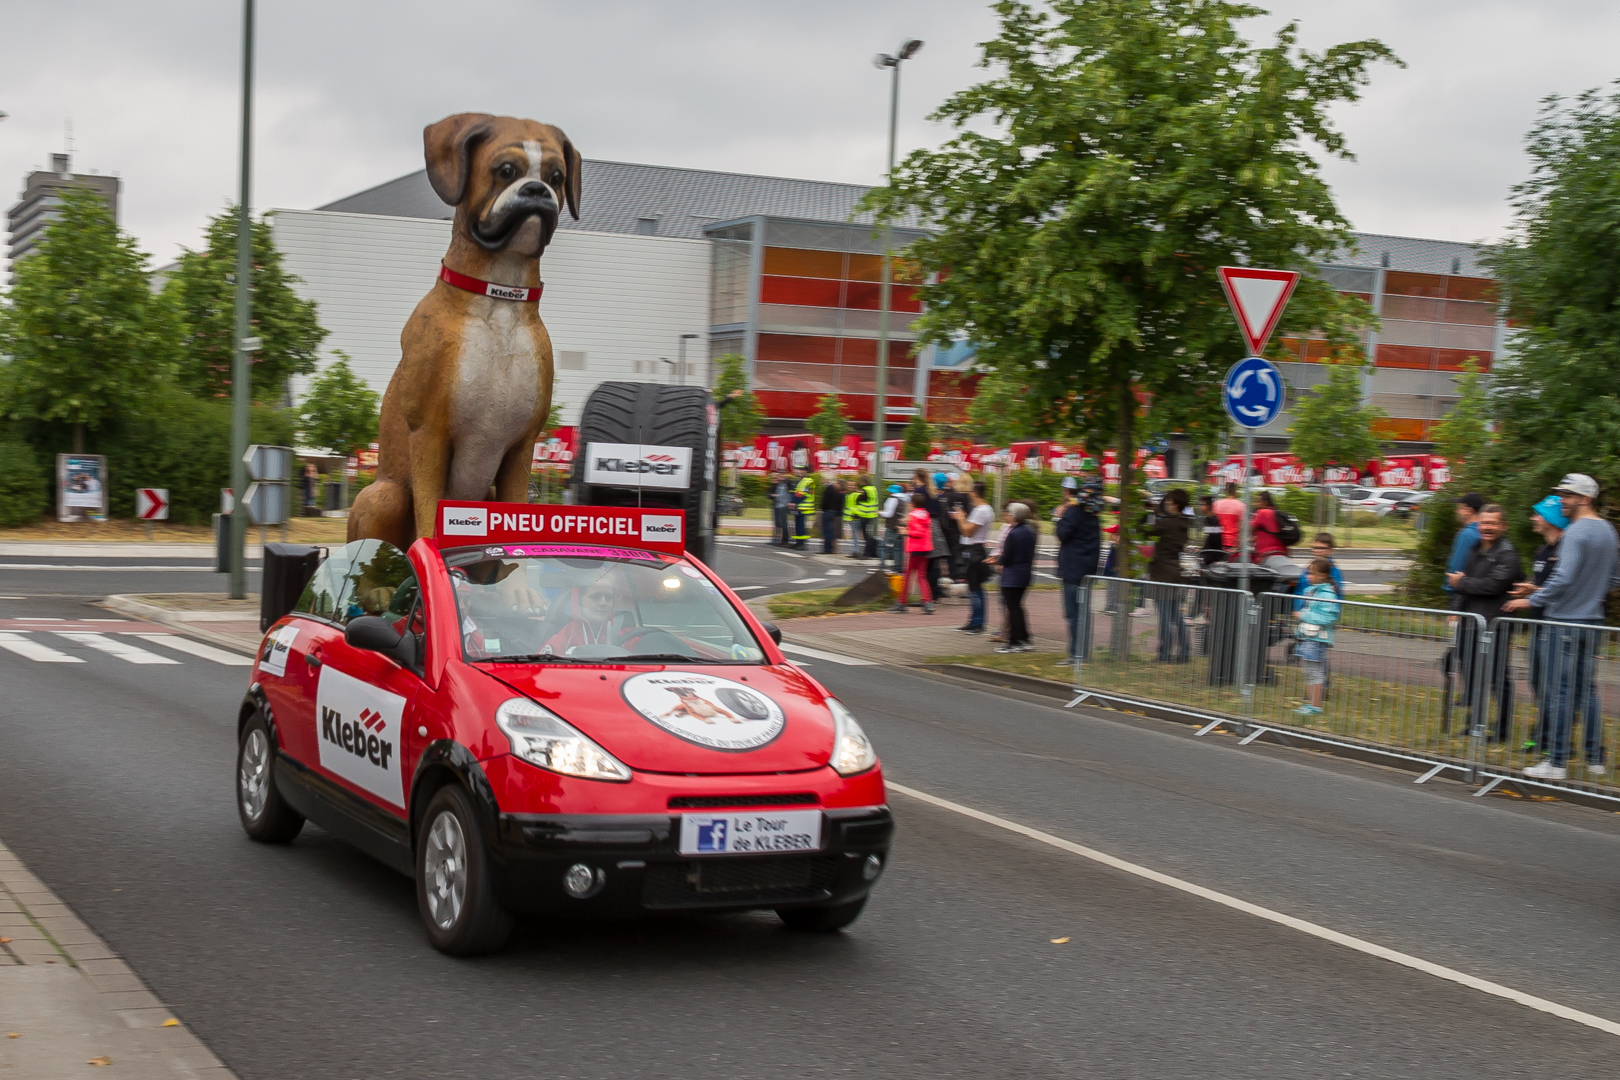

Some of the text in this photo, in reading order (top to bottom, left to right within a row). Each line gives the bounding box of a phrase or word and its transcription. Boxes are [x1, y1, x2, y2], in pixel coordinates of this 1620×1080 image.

[491, 288, 524, 299] Kleber
[594, 457, 682, 475] Kleber
[448, 518, 482, 526] Kleber
[490, 513, 639, 536] PNEU OFFICIEL
[646, 525, 677, 533] Kleber
[531, 547, 603, 555] CARAVANE
[322, 705, 392, 770] Kleber
[734, 816, 788, 832] Le Tour
[733, 833, 812, 851] de KLEBER
